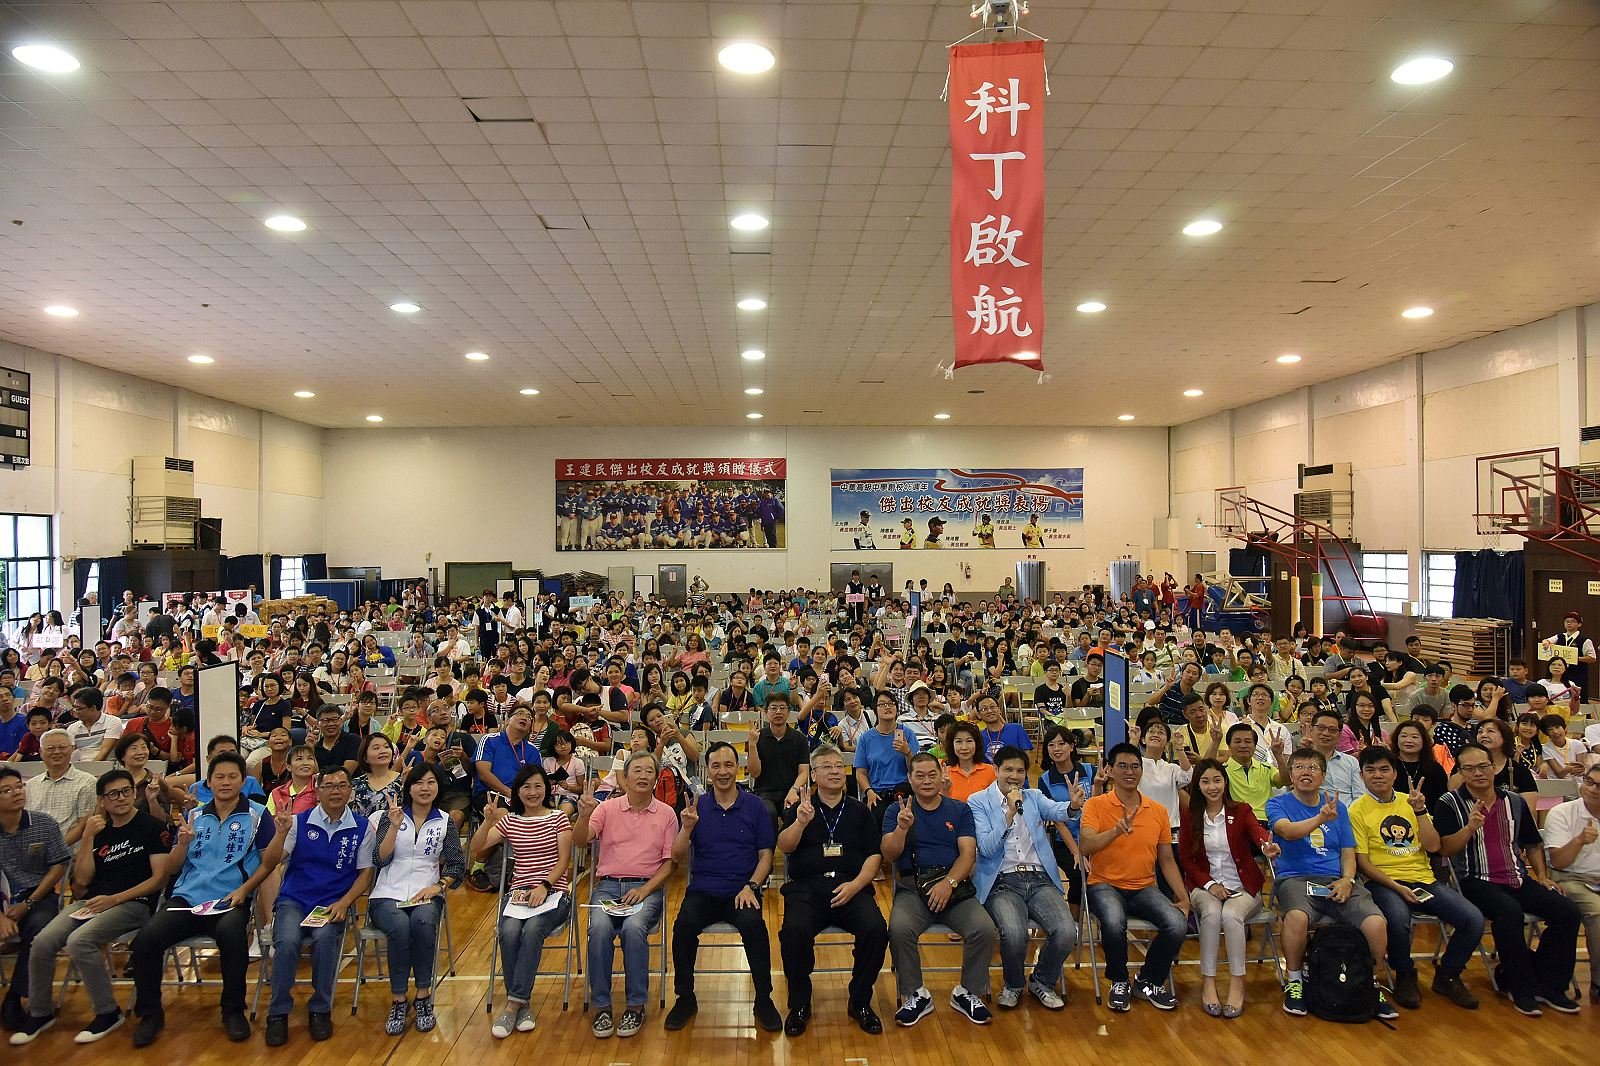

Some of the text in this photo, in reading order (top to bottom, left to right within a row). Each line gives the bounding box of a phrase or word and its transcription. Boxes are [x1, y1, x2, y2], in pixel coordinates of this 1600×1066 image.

[963, 78, 1033, 338] 科丁啟航
[11, 394, 30, 405] GUEST
[564, 461, 777, 478] 王建民傑出校友成就獎頒贈儀式
[879, 494, 1052, 514] 傑出校友成就獎表揚
[223, 832, 238, 864] 洪佳君
